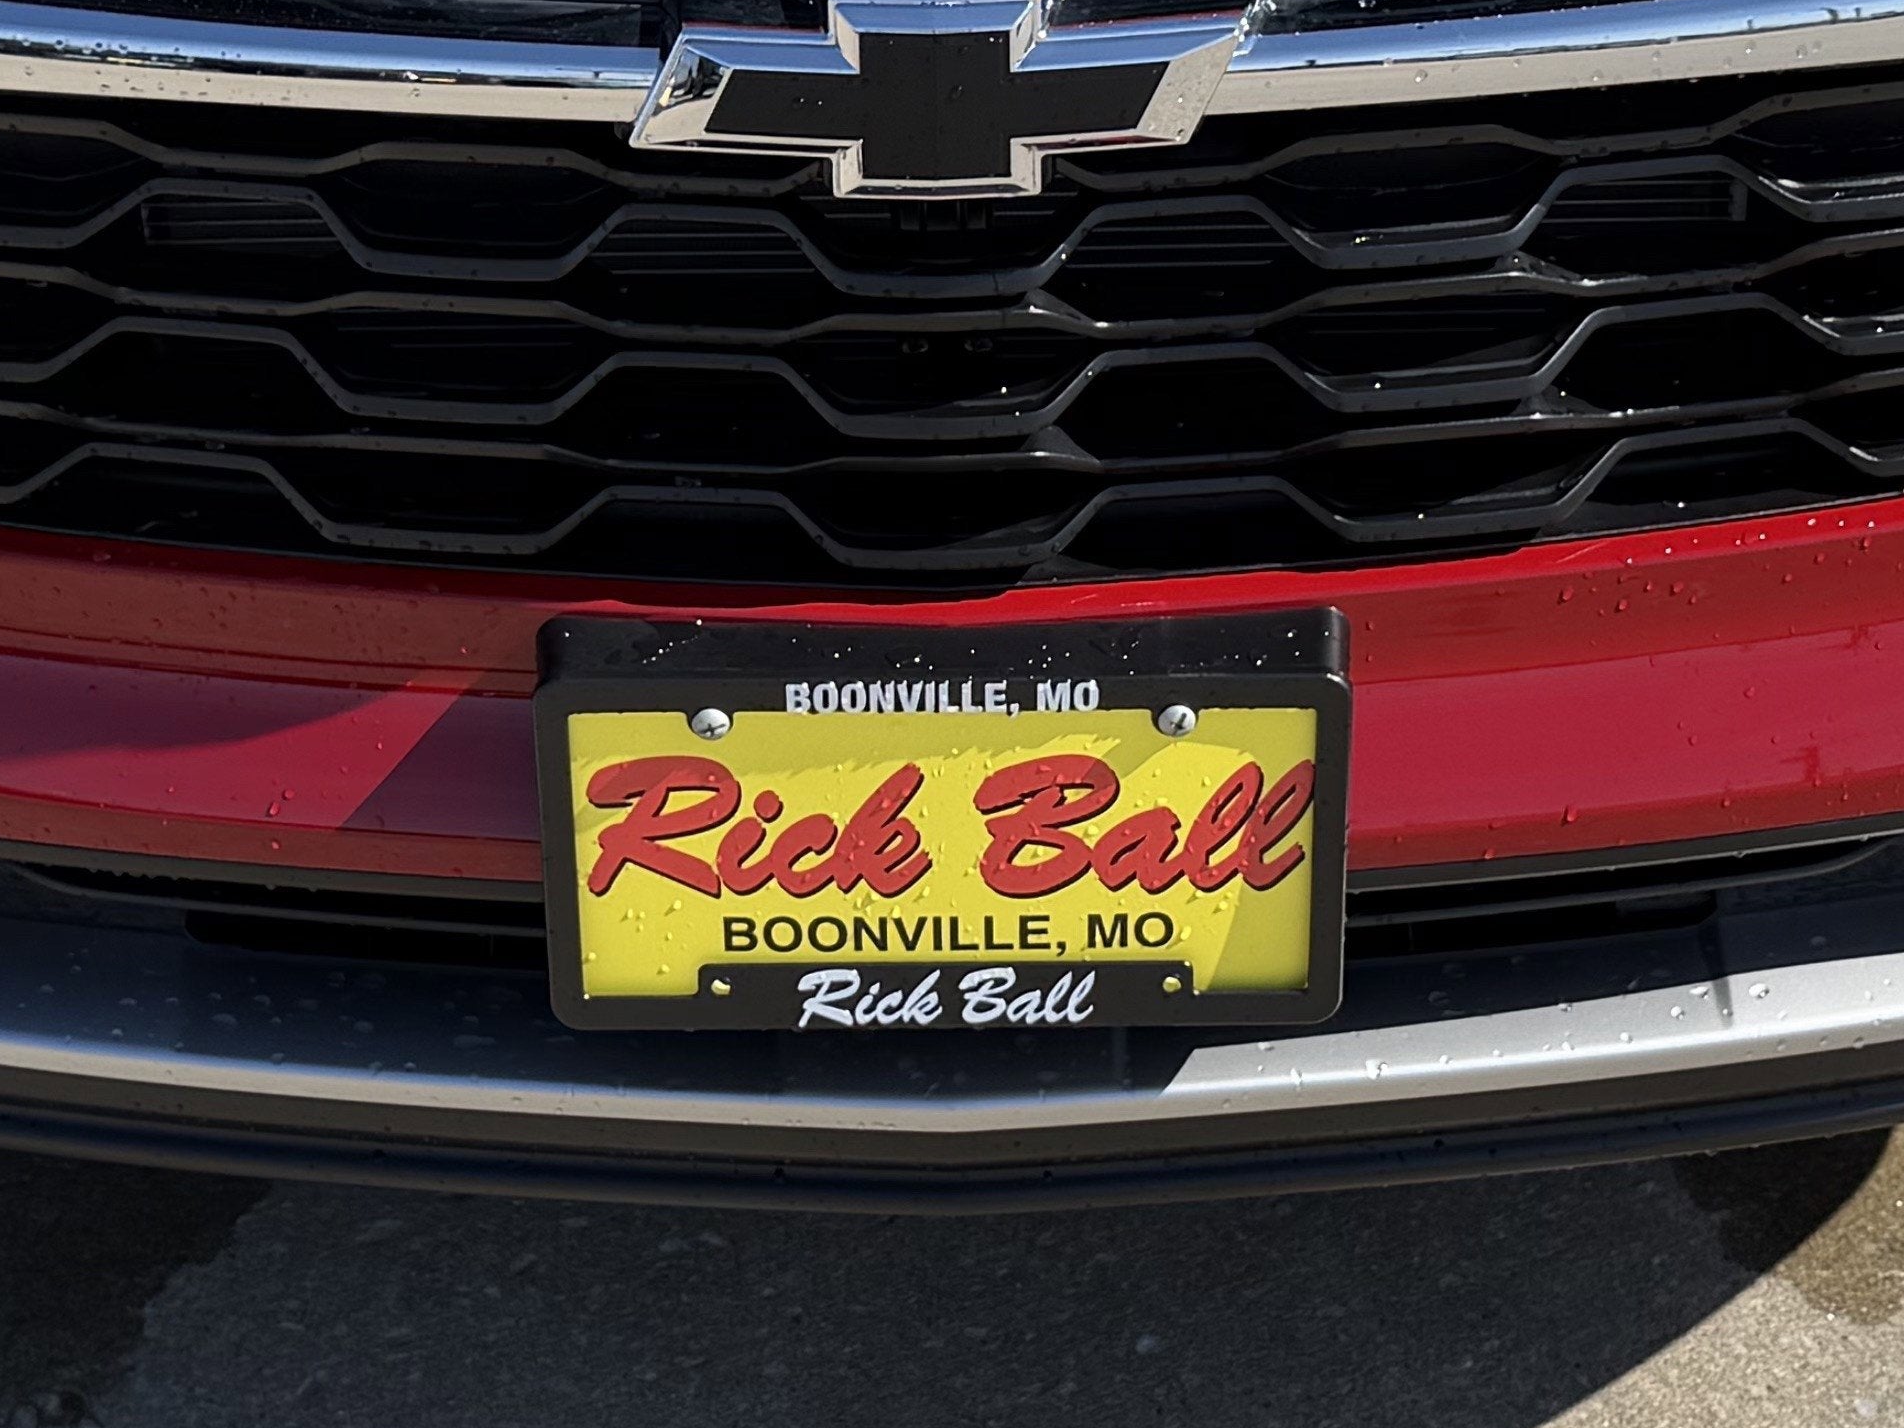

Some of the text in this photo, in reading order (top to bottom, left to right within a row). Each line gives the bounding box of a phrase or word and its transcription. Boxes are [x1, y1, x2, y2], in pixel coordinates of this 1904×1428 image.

[785, 679, 1100, 719] BOONVILLE, MO
[586, 754, 1317, 900] Rick Ball
[721, 911, 1175, 957] BOONVILLE, MO
[796, 968, 1095, 1029] Rick Ball
